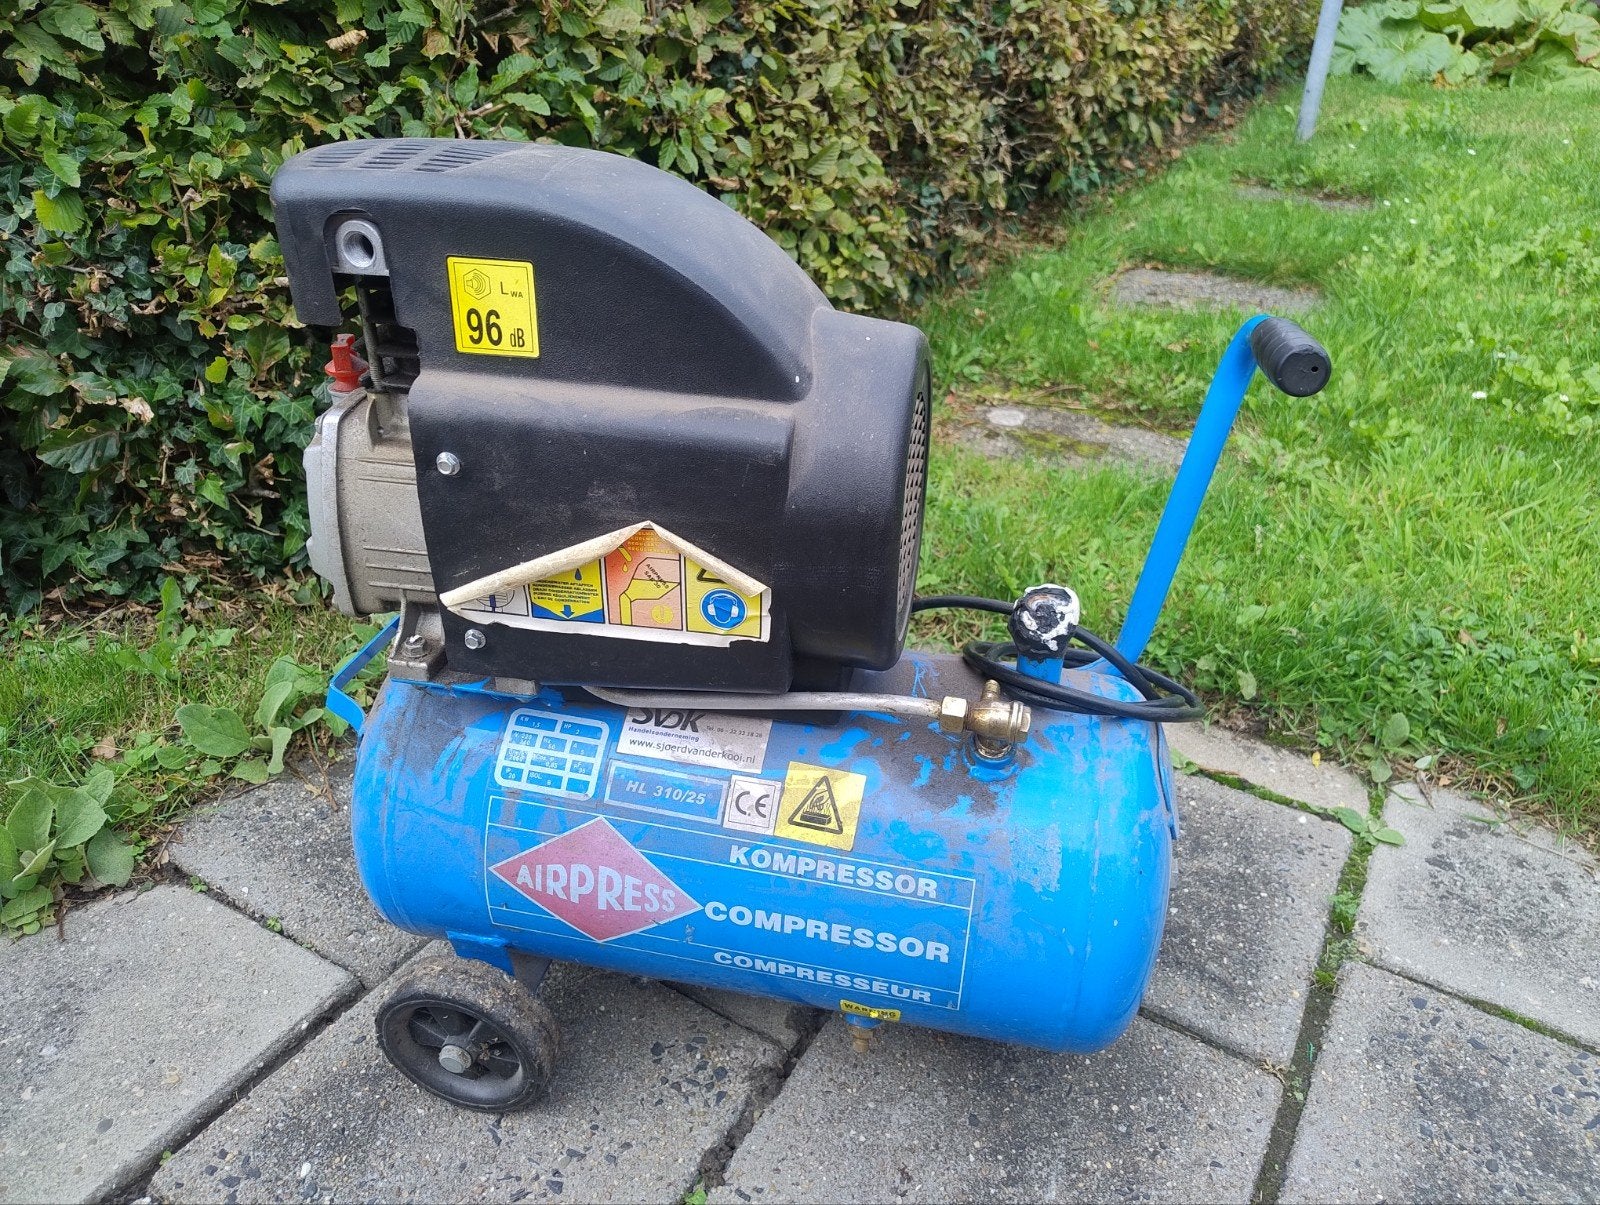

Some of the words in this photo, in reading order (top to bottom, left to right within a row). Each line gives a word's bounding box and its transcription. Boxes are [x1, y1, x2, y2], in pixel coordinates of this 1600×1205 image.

[466, 308, 503, 347] 96
[509, 328, 526, 348] dB
[628, 726, 700, 743] Handelsonderneming
[629, 738, 757, 764] www.sjoerdvanderkooi.nl
[625, 780, 648, 795] HL
[652, 785, 707, 806] 310/25
[516, 863, 676, 913] AIRPRESS
[729, 844, 938, 900] KOMPRESSOR
[704, 900, 950, 964] COMPRESSOR
[713, 951, 932, 1003] COMPRESSEUR
